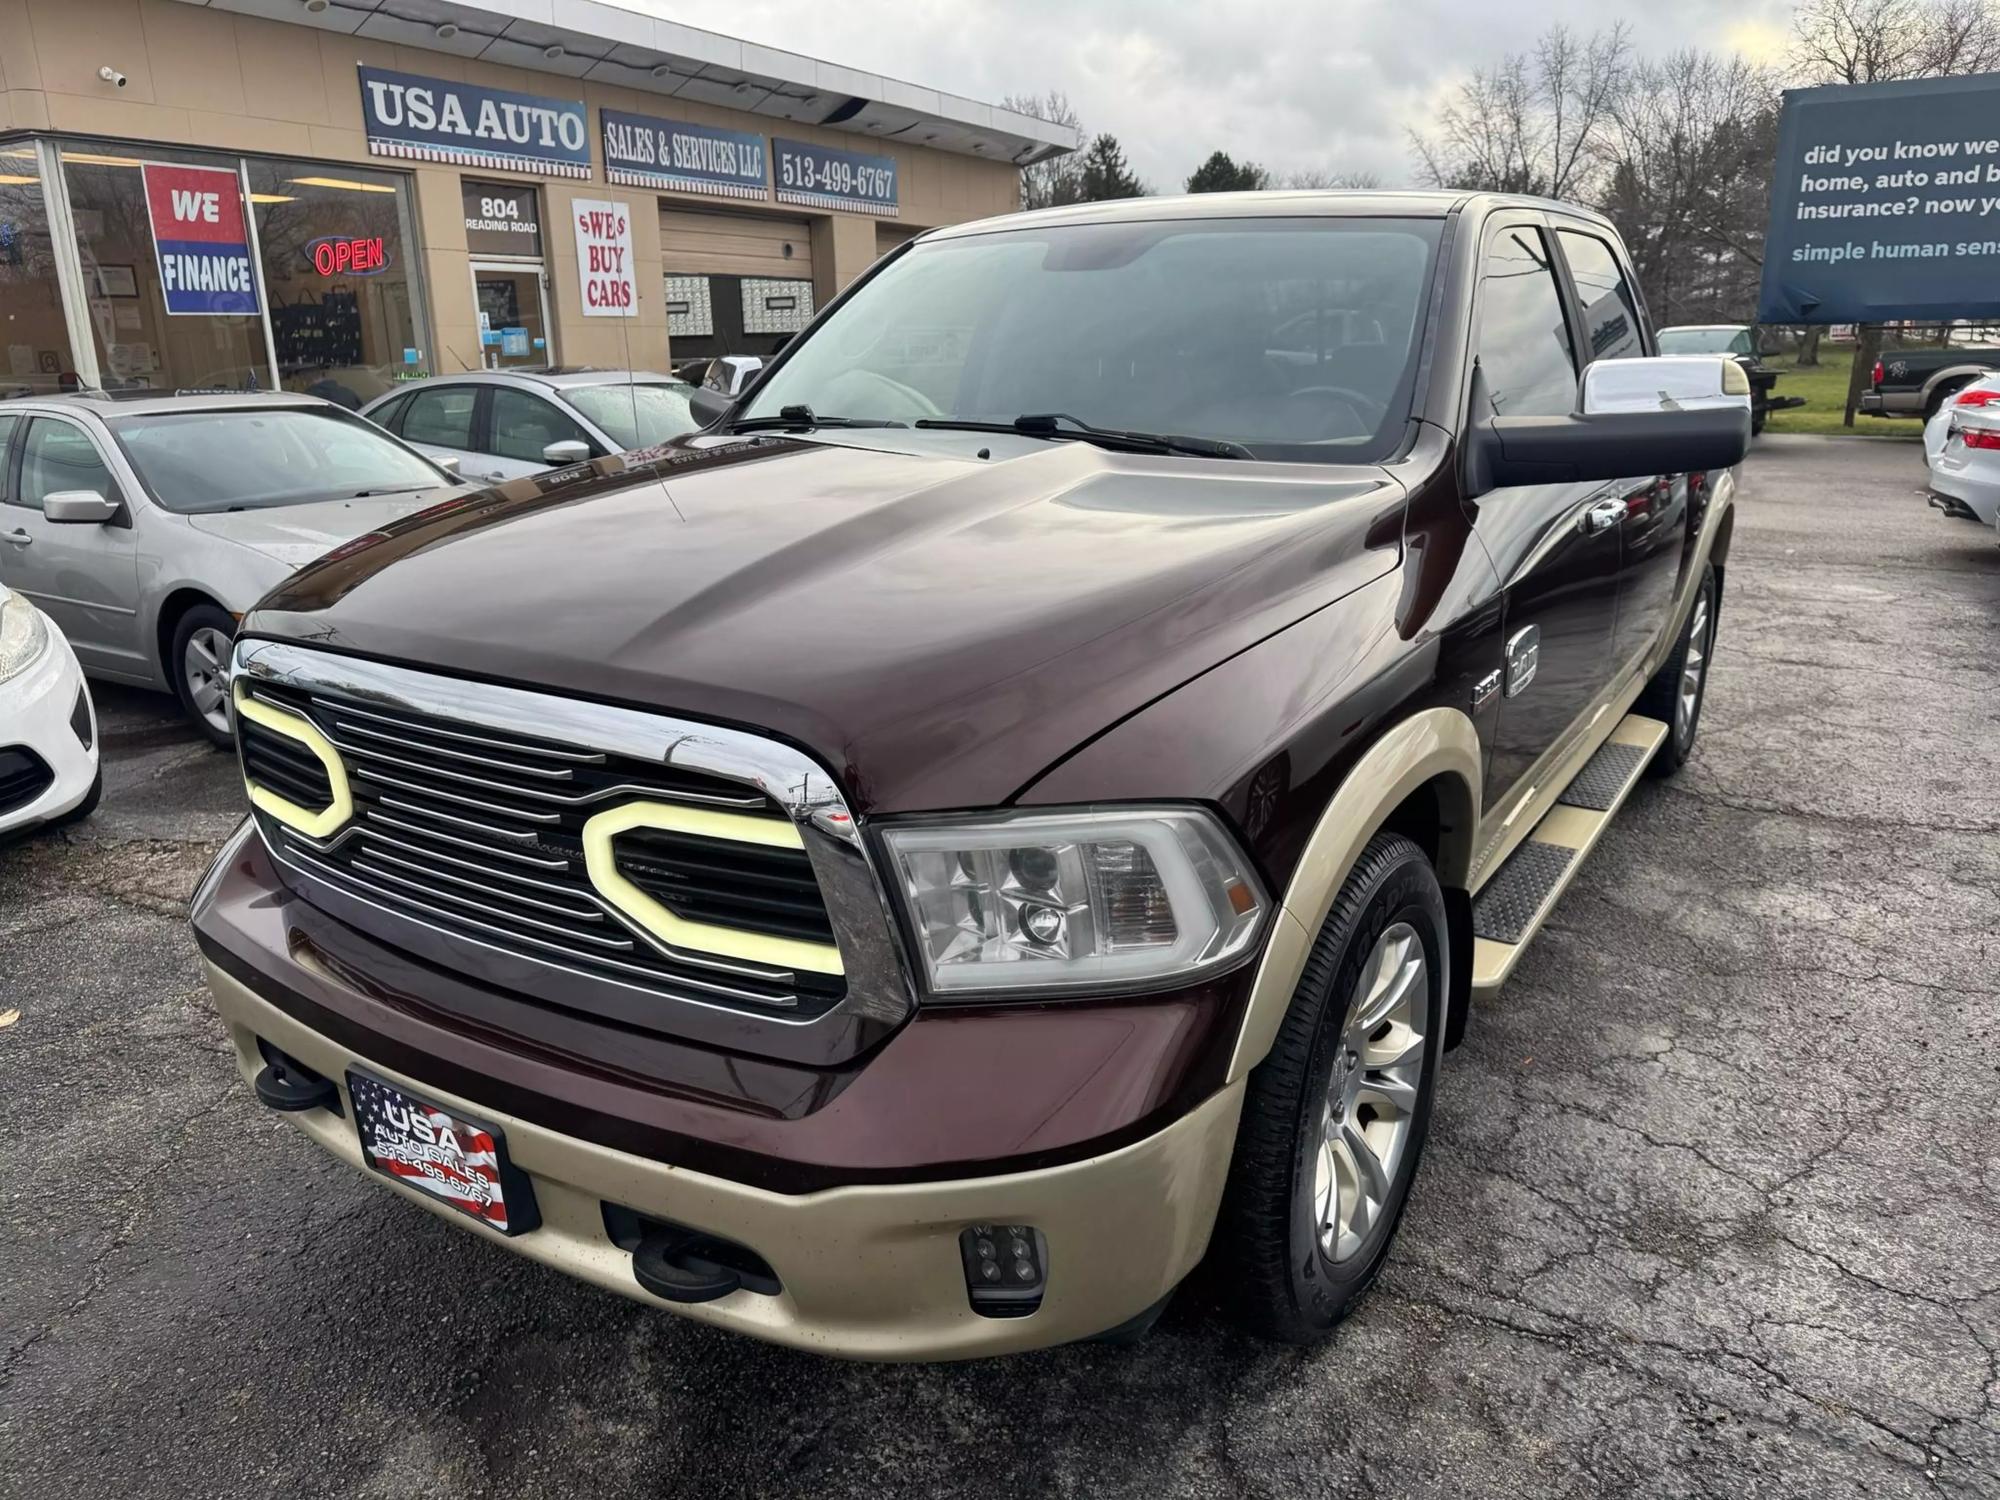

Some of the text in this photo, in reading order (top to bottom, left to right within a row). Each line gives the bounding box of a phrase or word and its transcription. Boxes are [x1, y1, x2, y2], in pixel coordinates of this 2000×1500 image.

[367, 80, 585, 151] USA AUTO
[606, 121, 762, 179] SALES & SERVICES LLC
[1804, 139, 2000, 167] did you know we
[782, 153, 893, 199] 513-499-6767
[1800, 174, 1870, 193] home,
[1875, 170, 1929, 188] auto
[1934, 164, 1981, 185] and
[171, 189, 220, 223] WE
[481, 197, 519, 220] 804
[1797, 196, 1920, 220] insurance?
[1924, 198, 1976, 215] now
[465, 218, 537, 233] READING ROAD
[315, 237, 384, 277] OPEN
[588, 245, 625, 274] BUY
[1792, 242, 1866, 265] simple
[1870, 241, 1949, 259] human
[163, 254, 251, 292] FINANCE
[587, 279, 631, 307] CARS
[384, 1100, 465, 1160] USA
[374, 1123, 490, 1190] AUTO SALES
